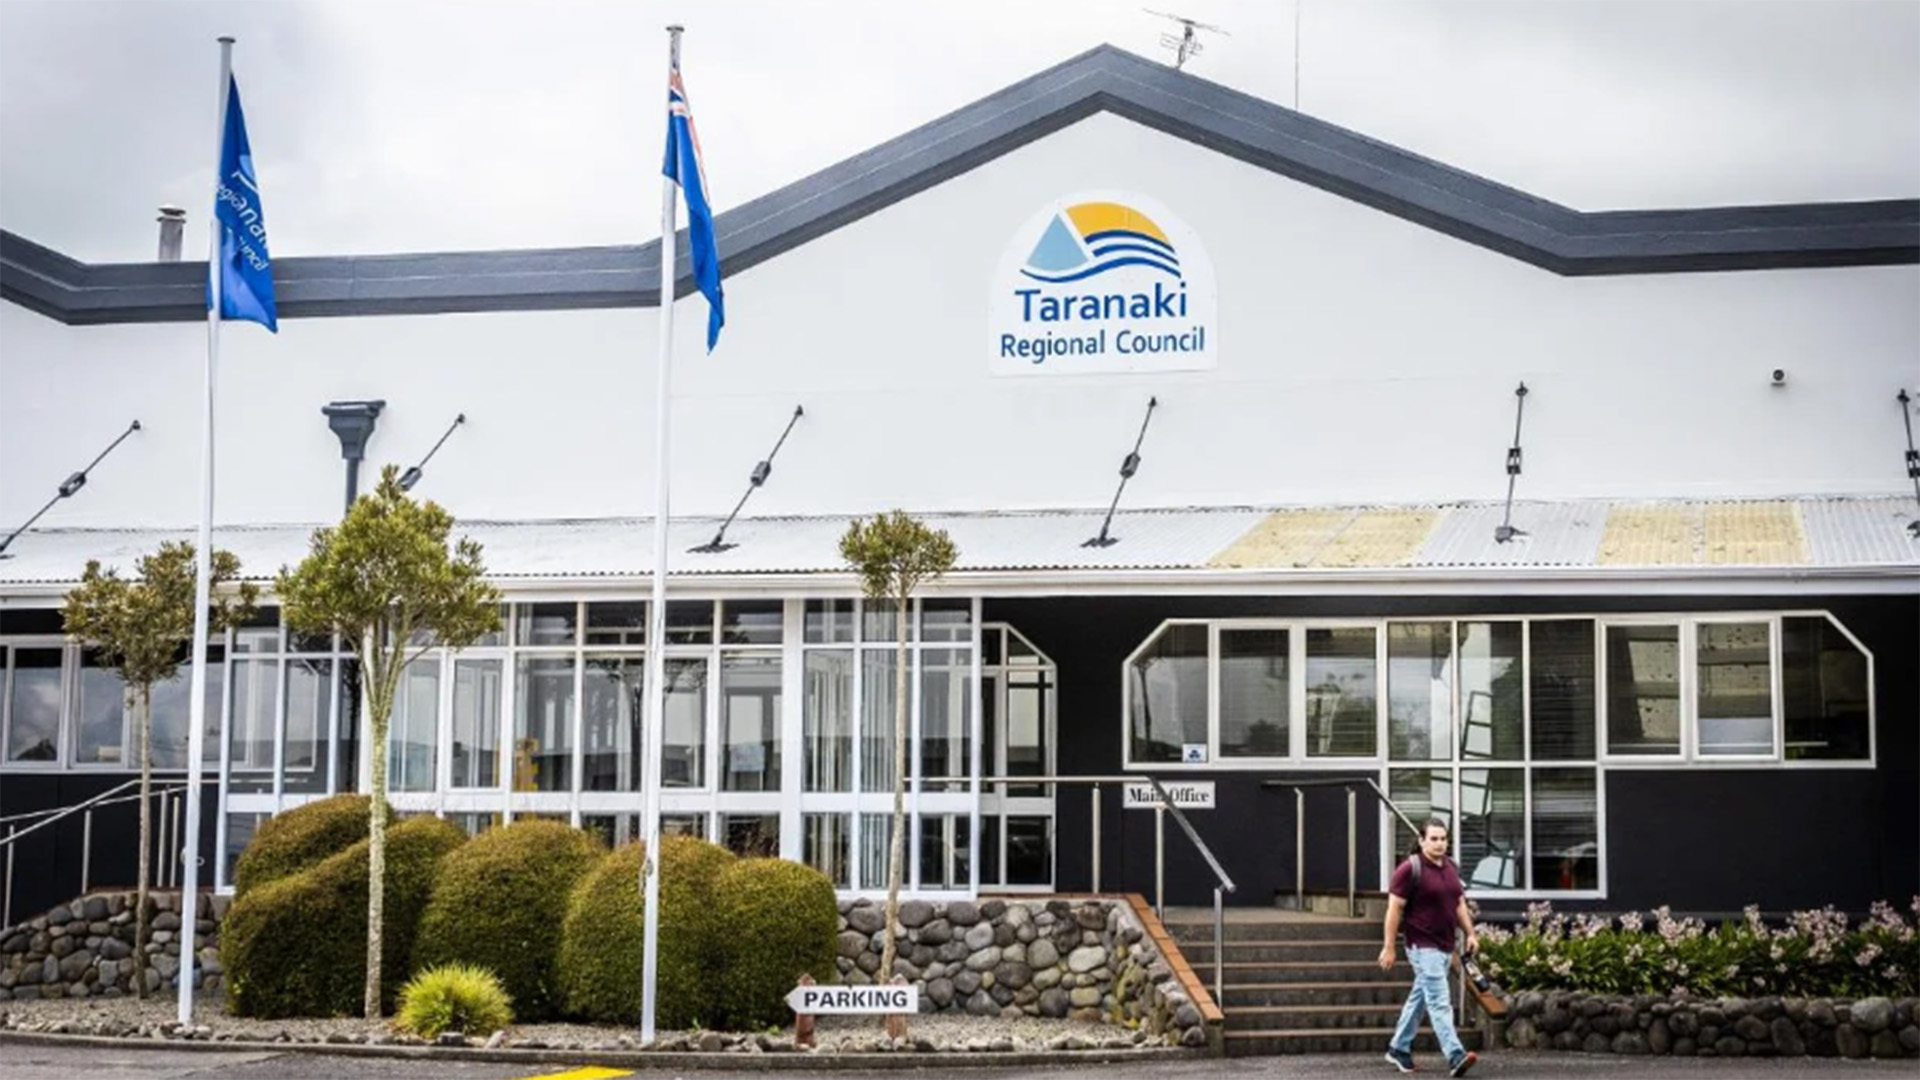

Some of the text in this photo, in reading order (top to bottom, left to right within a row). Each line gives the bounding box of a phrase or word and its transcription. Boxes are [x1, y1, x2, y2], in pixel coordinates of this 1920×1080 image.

[1014, 282, 1187, 322] Taranaki
[1001, 326, 1205, 364] Regional Council
[1129, 787, 1209, 803] Mai Office
[804, 990, 908, 1008] PARKING
